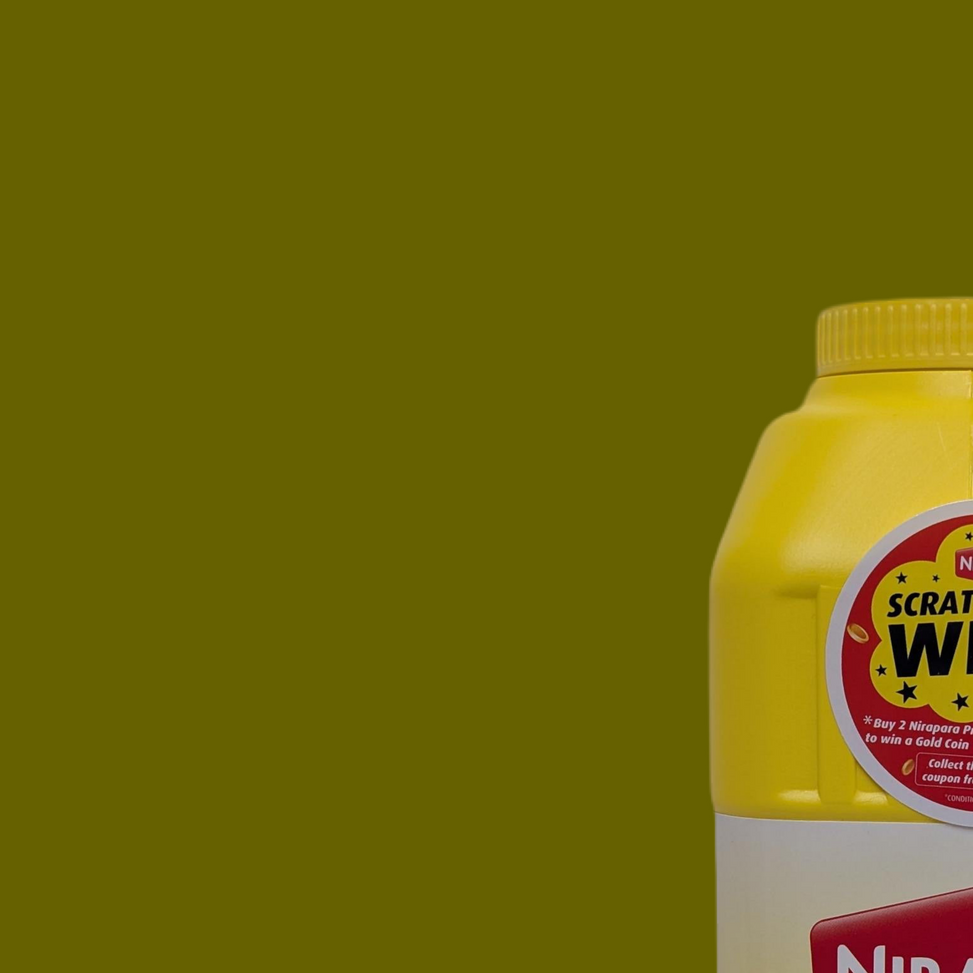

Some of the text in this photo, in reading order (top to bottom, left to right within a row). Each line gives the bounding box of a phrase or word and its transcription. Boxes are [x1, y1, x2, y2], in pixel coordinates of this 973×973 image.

[898, 720, 907, 730] 2
[909, 721, 960, 735] Nirapara
[865, 733, 877, 743] to
[881, 734, 902, 745] win
[904, 737, 913, 746] a
[915, 737, 942, 748] Gold
[945, 739, 969, 750] Coin
[928, 758, 965, 770] Collect
[922, 774, 960, 785] coupon
